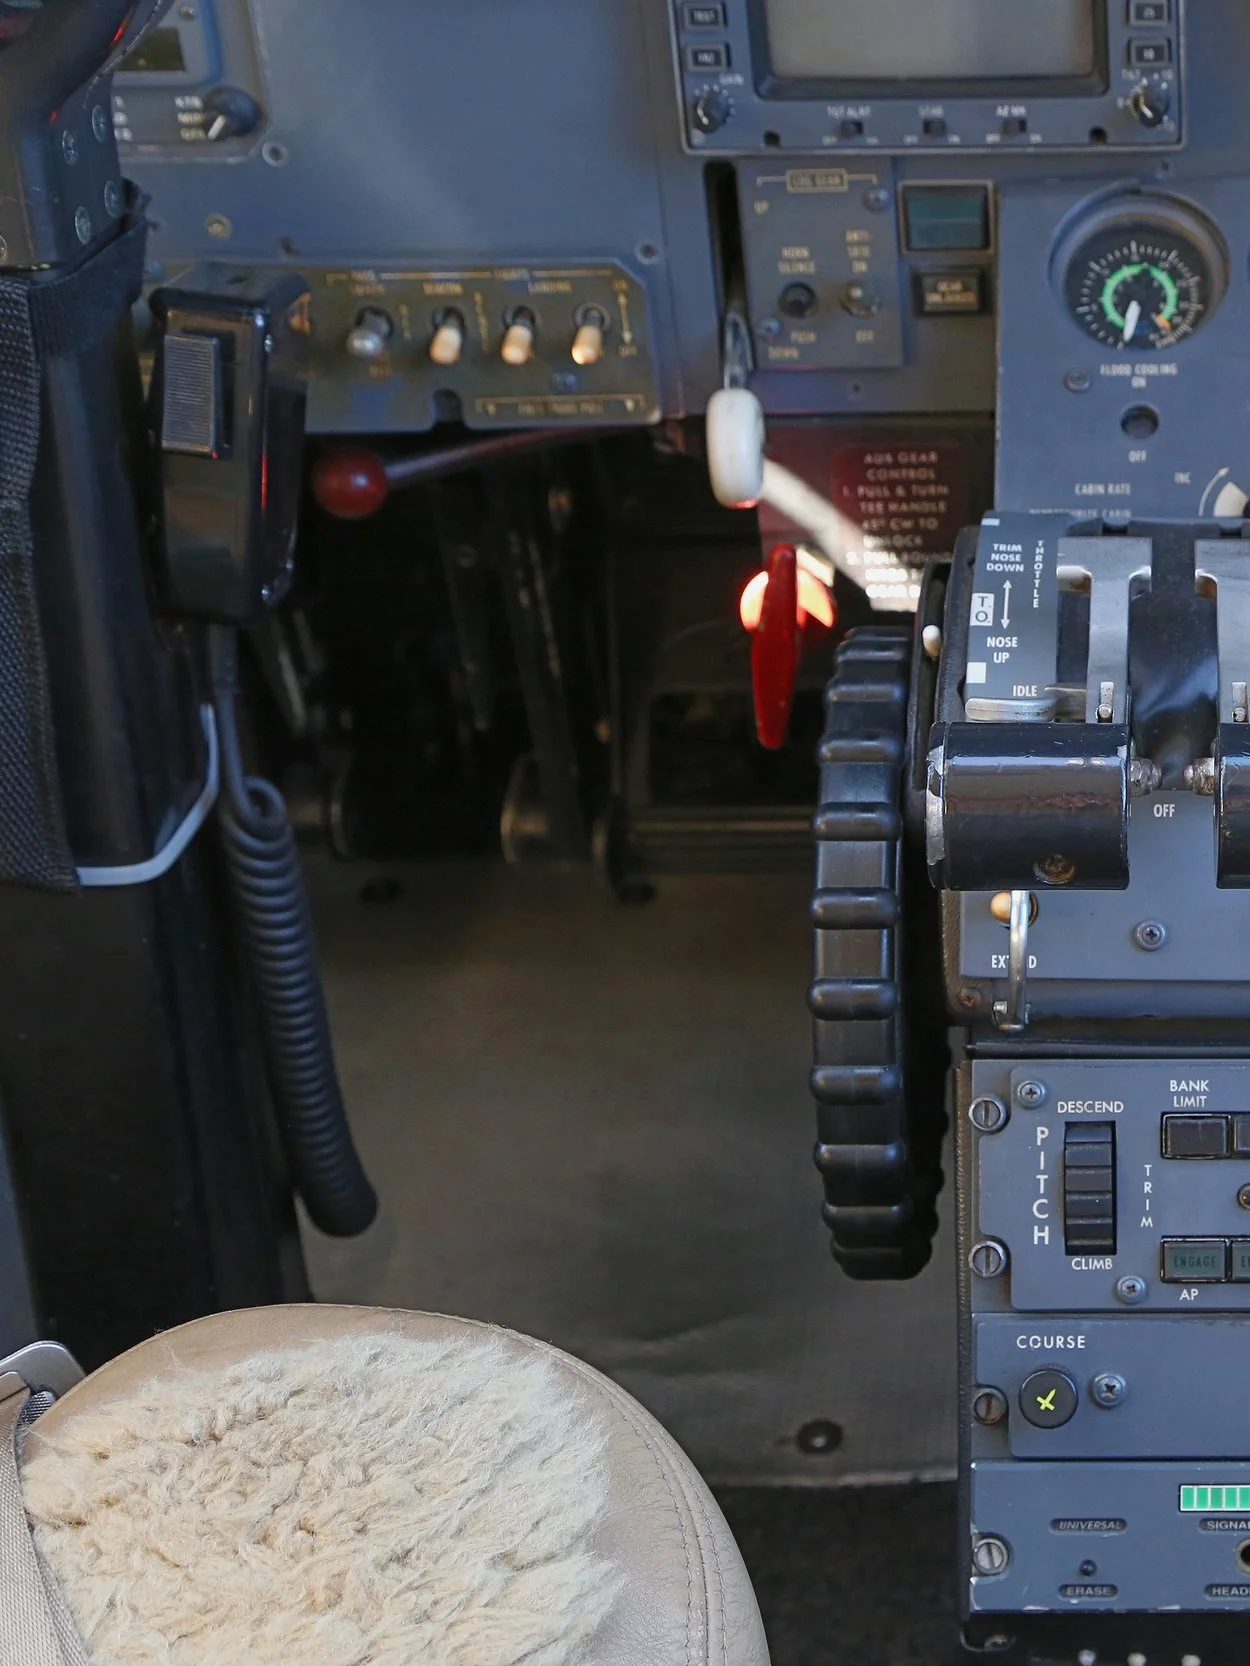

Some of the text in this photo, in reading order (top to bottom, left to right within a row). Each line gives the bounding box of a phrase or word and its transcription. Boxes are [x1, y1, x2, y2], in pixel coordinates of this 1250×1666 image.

[866, 467, 936, 481] CONTROL
[993, 544, 1022, 552] TRIM
[991, 553, 1021, 562] NOSE
[986, 563, 1024, 572] DOWN
[1033, 540, 1044, 608] THROTTLE
[986, 637, 1018, 648] NOSE
[993, 652, 1010, 663] UP
[1012, 685, 1037, 697] IDLE
[1153, 804, 1176, 817] OFF
[1169, 1079, 1209, 1092] BANK
[1057, 1101, 1124, 1113] DESCEND
[1173, 1096, 1207, 1107] LIMIT
[1032, 1126, 1050, 1245] PITCH
[1140, 1164, 1154, 1228] TRIM
[1071, 1258, 1113, 1270] CLIMB
[1174, 1255, 1217, 1268] ENGAGE
[1179, 1289, 1199, 1300] AP
[1016, 1335, 1086, 1348] COURSE
[1058, 1520, 1123, 1530] UNIVERSAL
[1066, 1586, 1111, 1597] ERASE
